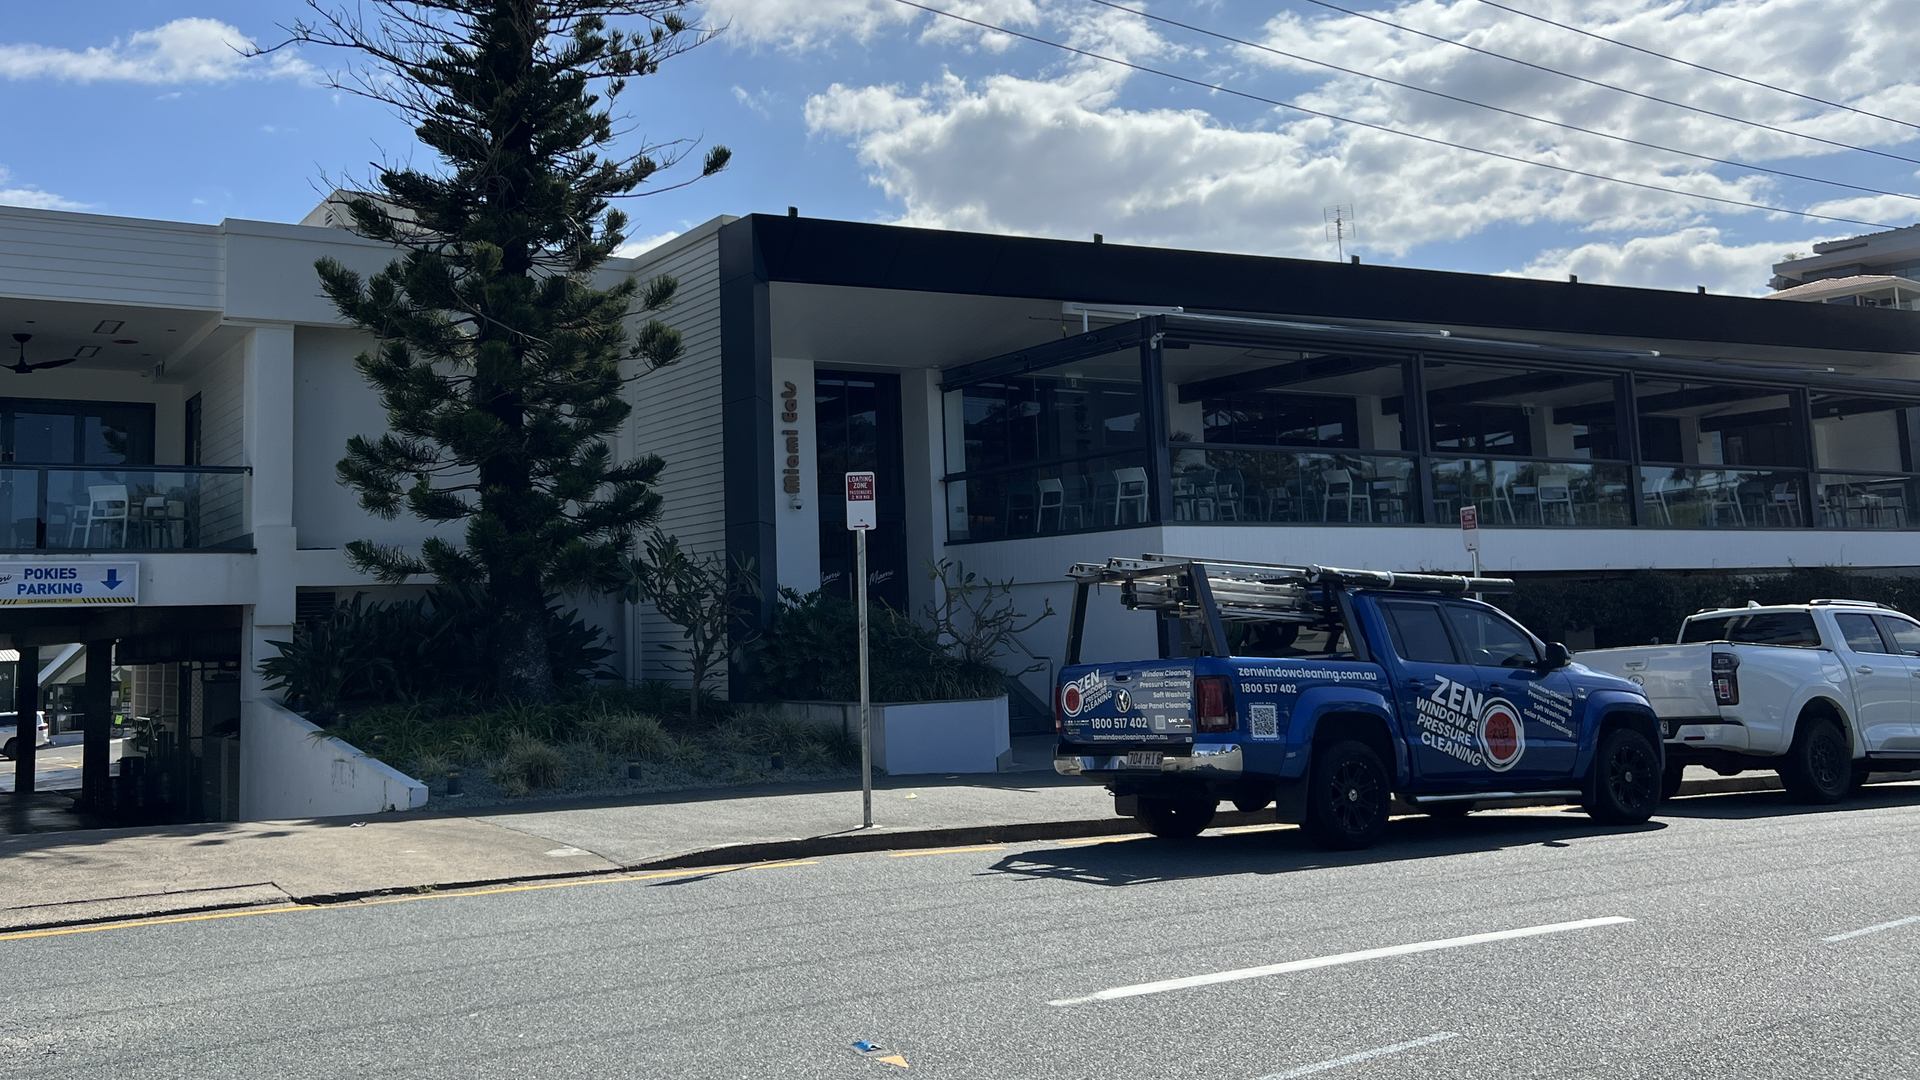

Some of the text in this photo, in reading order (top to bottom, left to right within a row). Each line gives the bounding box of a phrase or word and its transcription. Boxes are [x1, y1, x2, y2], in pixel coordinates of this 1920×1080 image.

[24, 567, 77, 580] POKIES
[17, 583, 83, 595] PARKING
[1078, 669, 1100, 693] ZEN
[1165, 669, 1191, 678] Cleaning
[1238, 666, 1377, 682] zenwindowcleaning.com.au
[1165, 680, 1191, 689] Cleaning
[1240, 683, 1297, 693] 1800 517 402
[1528, 680, 1550, 695] Window
[1550, 690, 1572, 706] Cleaning
[1084, 690, 1112, 713] CLEANING
[1165, 691, 1191, 699] Washing
[1431, 674, 1484, 720] ZEN
[1528, 690, 1572, 716] Pressure Cleaning
[1165, 702, 1191, 710] Cleaning
[1416, 696, 1476, 733] WINDOW &
[1533, 703, 1566, 724] Soft Washing
[1091, 718, 1112, 729] 1800
[1114, 718, 1128, 729] 517
[1130, 718, 1148, 728] 402
[1417, 713, 1471, 746] PRESSURE
[1523, 708, 1572, 738] Solar Panel Cleaning
[1093, 734, 1168, 742] zenwindowcleaning.com.au
[1421, 732, 1482, 766] CLEANING
